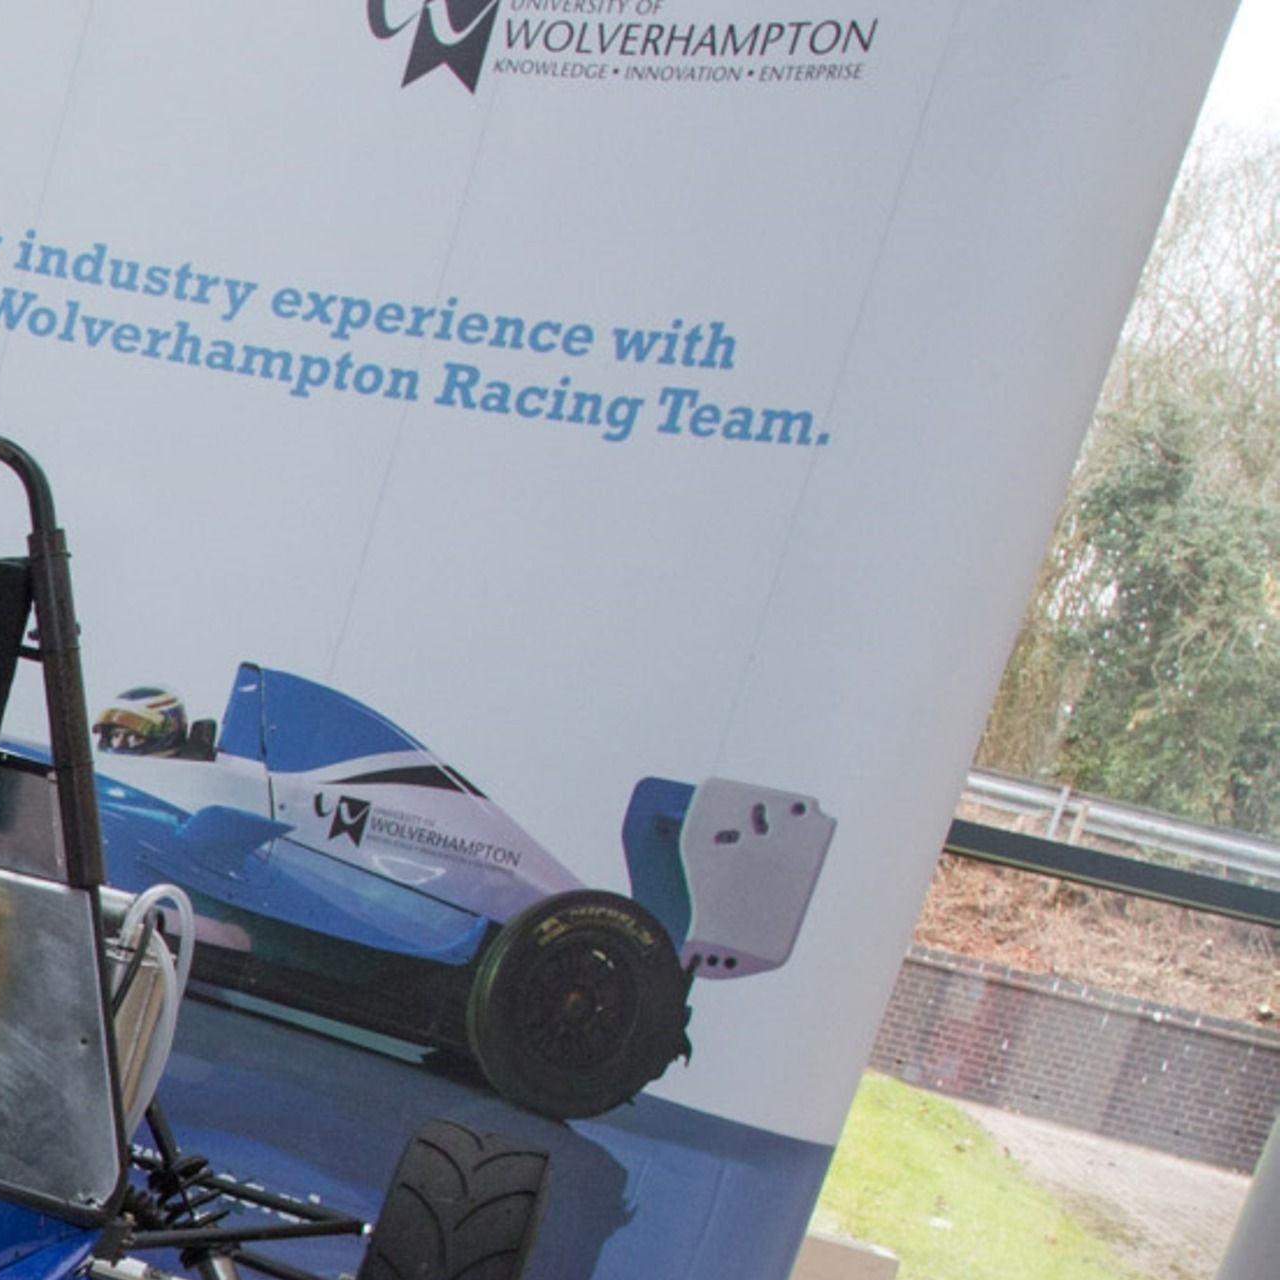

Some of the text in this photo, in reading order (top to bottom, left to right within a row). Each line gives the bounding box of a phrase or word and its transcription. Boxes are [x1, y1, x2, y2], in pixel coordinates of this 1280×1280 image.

[635, 0, 664, 15] OF
[505, 19, 879, 56] WOLVERHAMPTON
[492, 58, 865, 83] KNOWLEDGE INNOVATION ENTERPRISE
[13, 229, 259, 321] industry
[271, 283, 596, 360] experience
[610, 318, 739, 371] with
[435, 360, 645, 444] Racing
[656, 386, 832, 447] Team.
[370, 815, 523, 867] WOLVERHAMPTON
